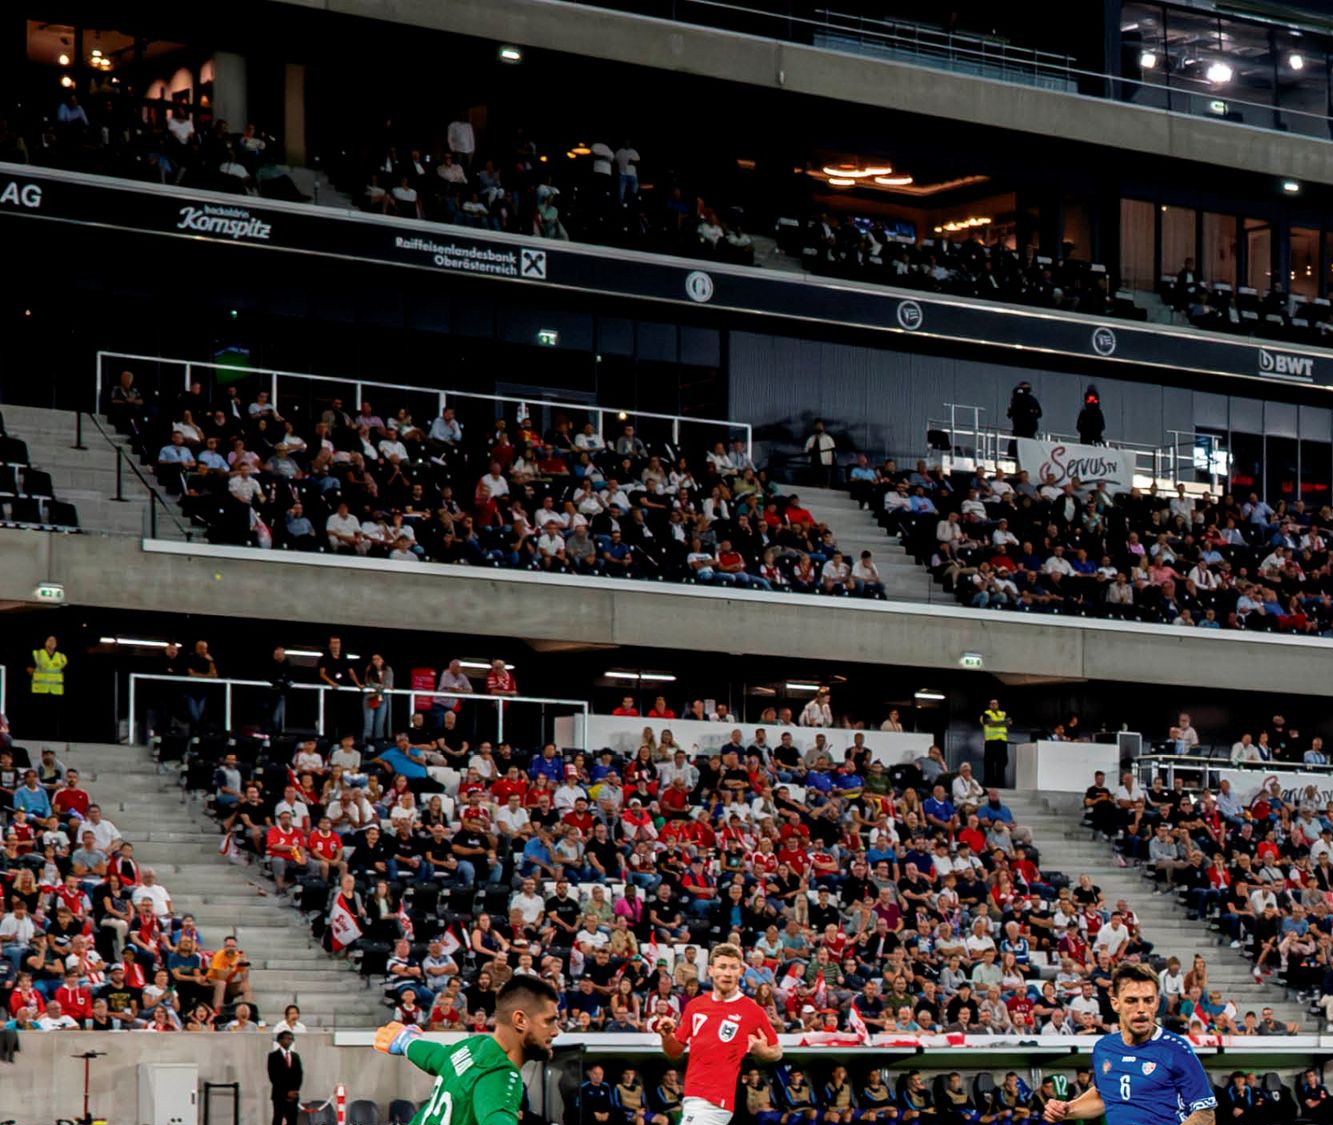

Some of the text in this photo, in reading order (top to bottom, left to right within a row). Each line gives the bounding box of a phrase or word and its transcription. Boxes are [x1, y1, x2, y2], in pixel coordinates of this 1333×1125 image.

[0, 182, 42, 208] AG
[177, 206, 272, 239] Kornspitz
[395, 236, 517, 264] Raiffeisenlandesbank
[434, 254, 518, 276] Oberösterreich
[1275, 354, 1313, 376] BWT
[1053, 1075, 1068, 1096] 12
[1120, 1074, 1131, 1101] 6
